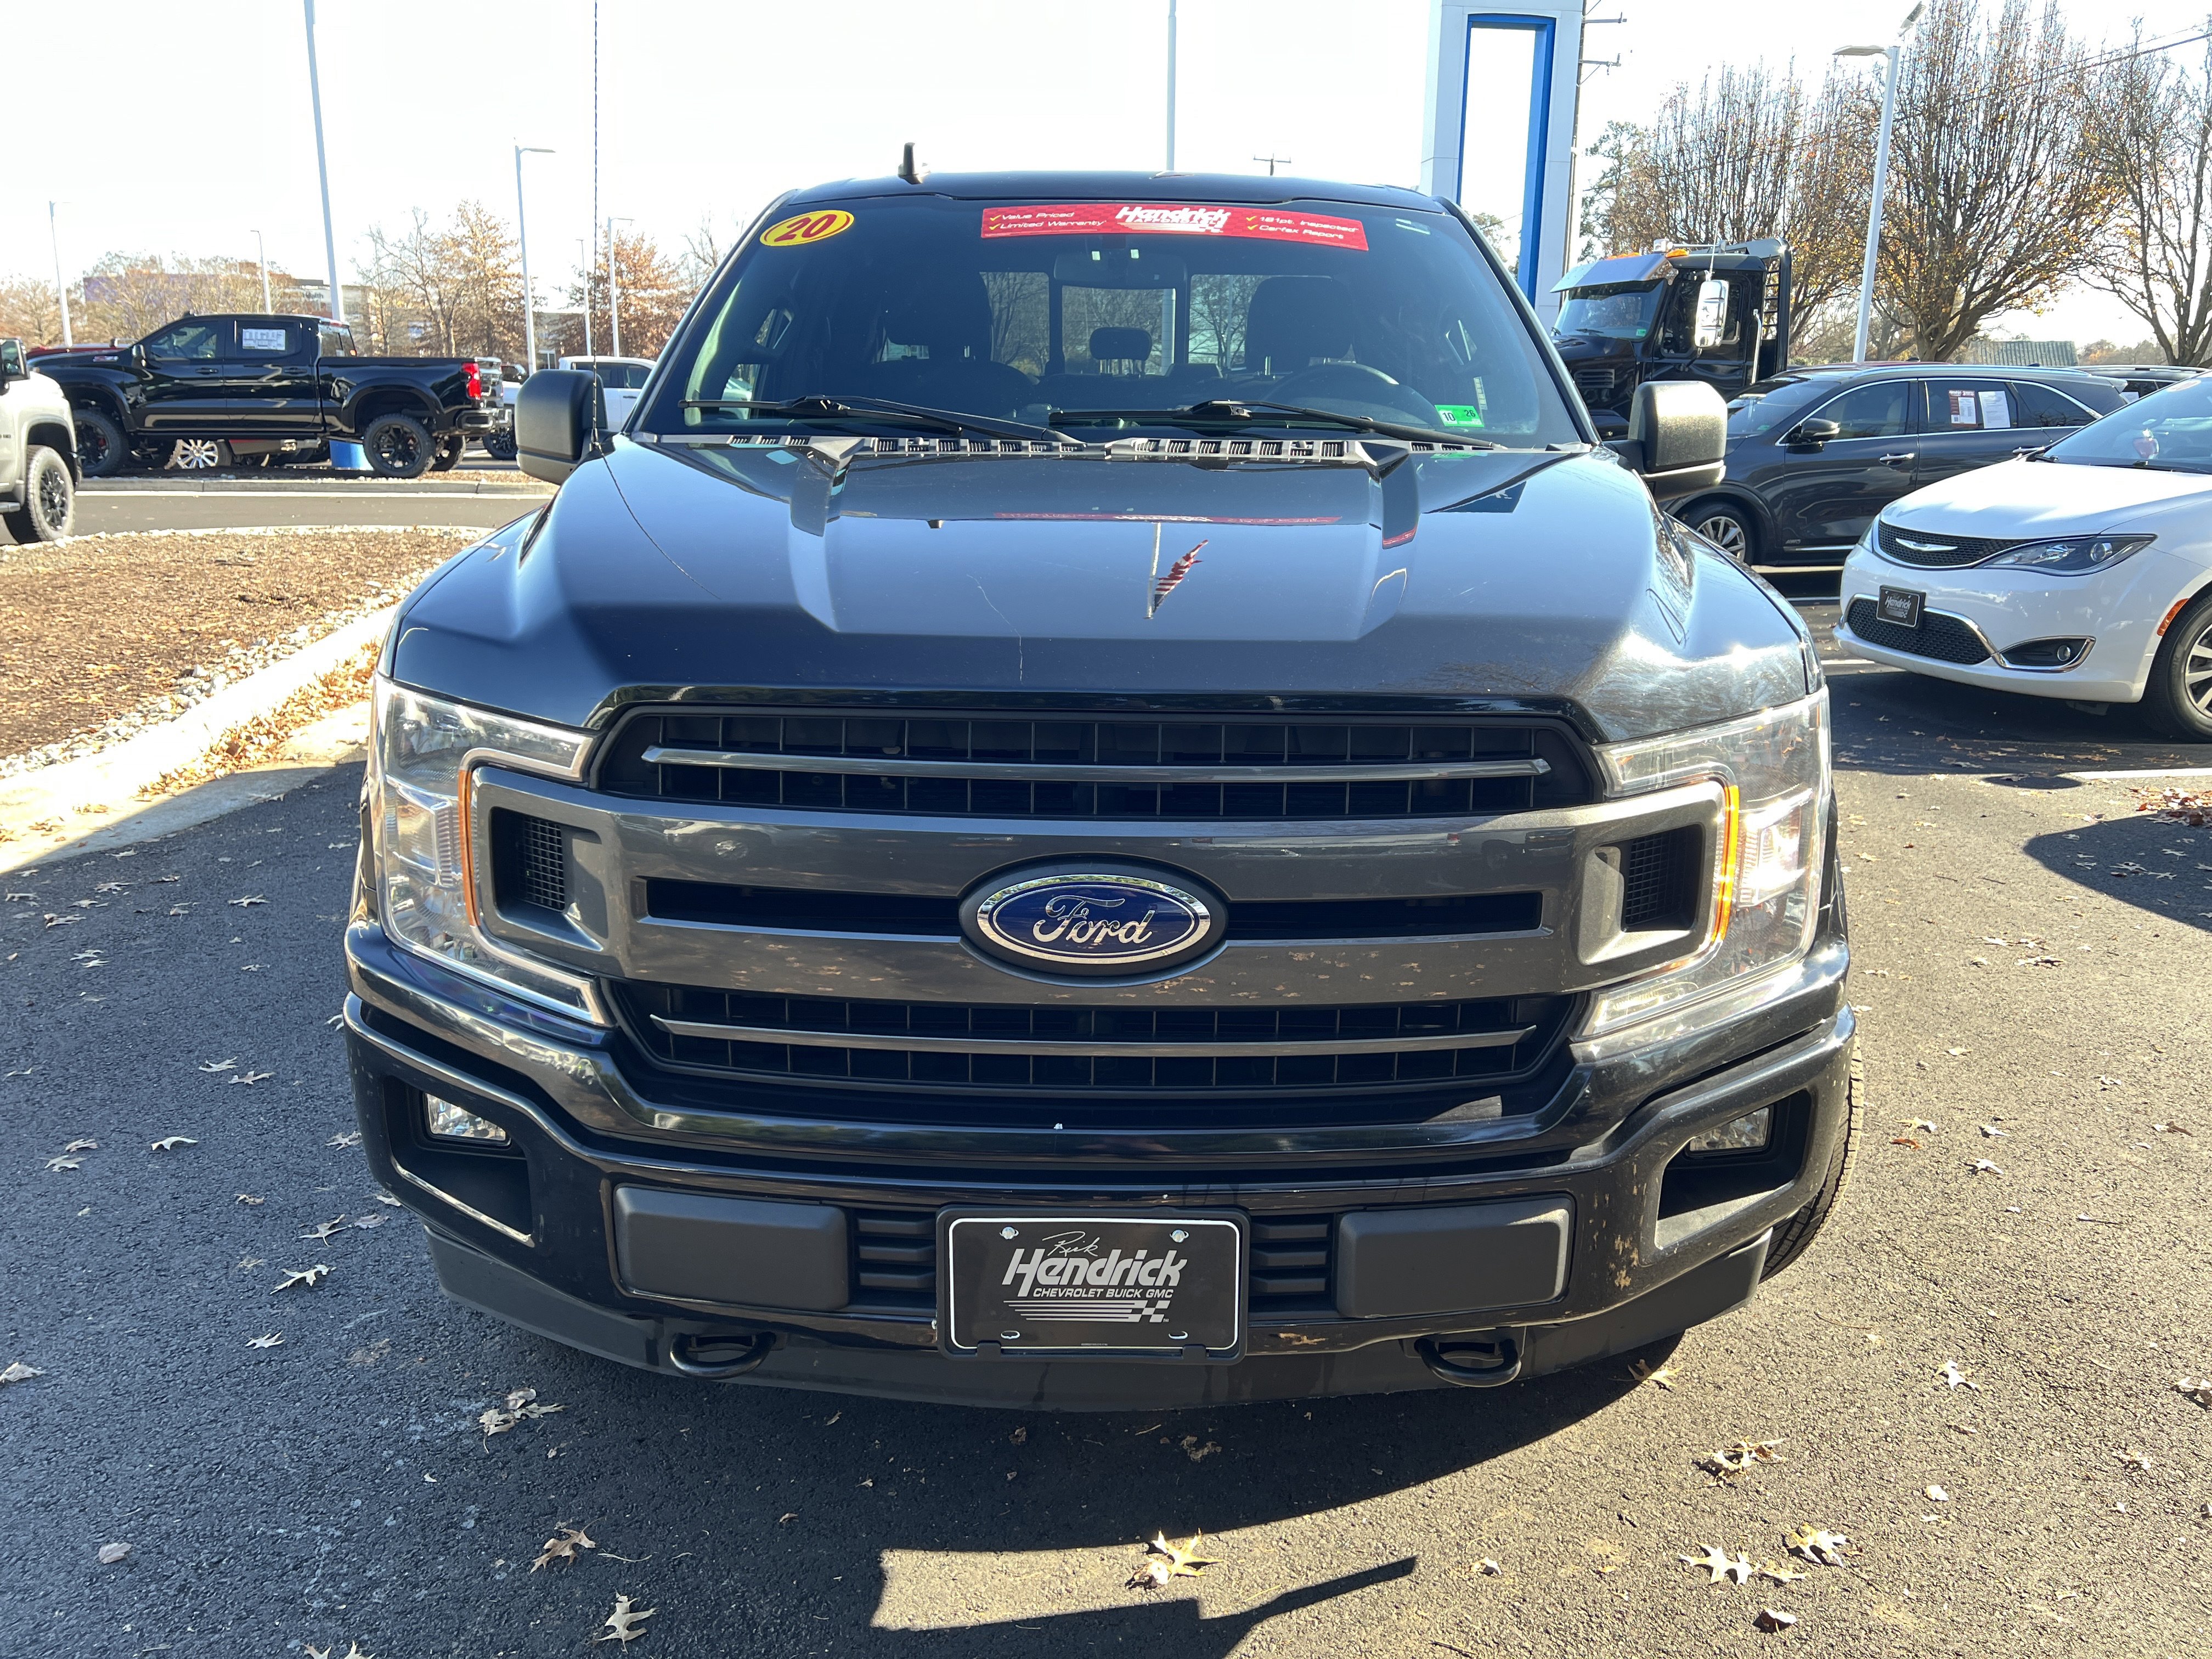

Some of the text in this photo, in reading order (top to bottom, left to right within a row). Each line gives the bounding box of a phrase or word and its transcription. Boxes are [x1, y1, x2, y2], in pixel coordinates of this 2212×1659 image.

[1115, 206, 1231, 228] Hendrick
[774, 214, 837, 242] 20
[1259, 225, 1344, 239] Carfax Report
[1442, 412, 1456, 421] 10
[1884, 596, 1911, 610] Hendrick
[1032, 895, 1155, 944] Ford
[1002, 1248, 1188, 1297] Hendrick
[1032, 1288, 1174, 1299] CHEVROLET BUICK GMC
